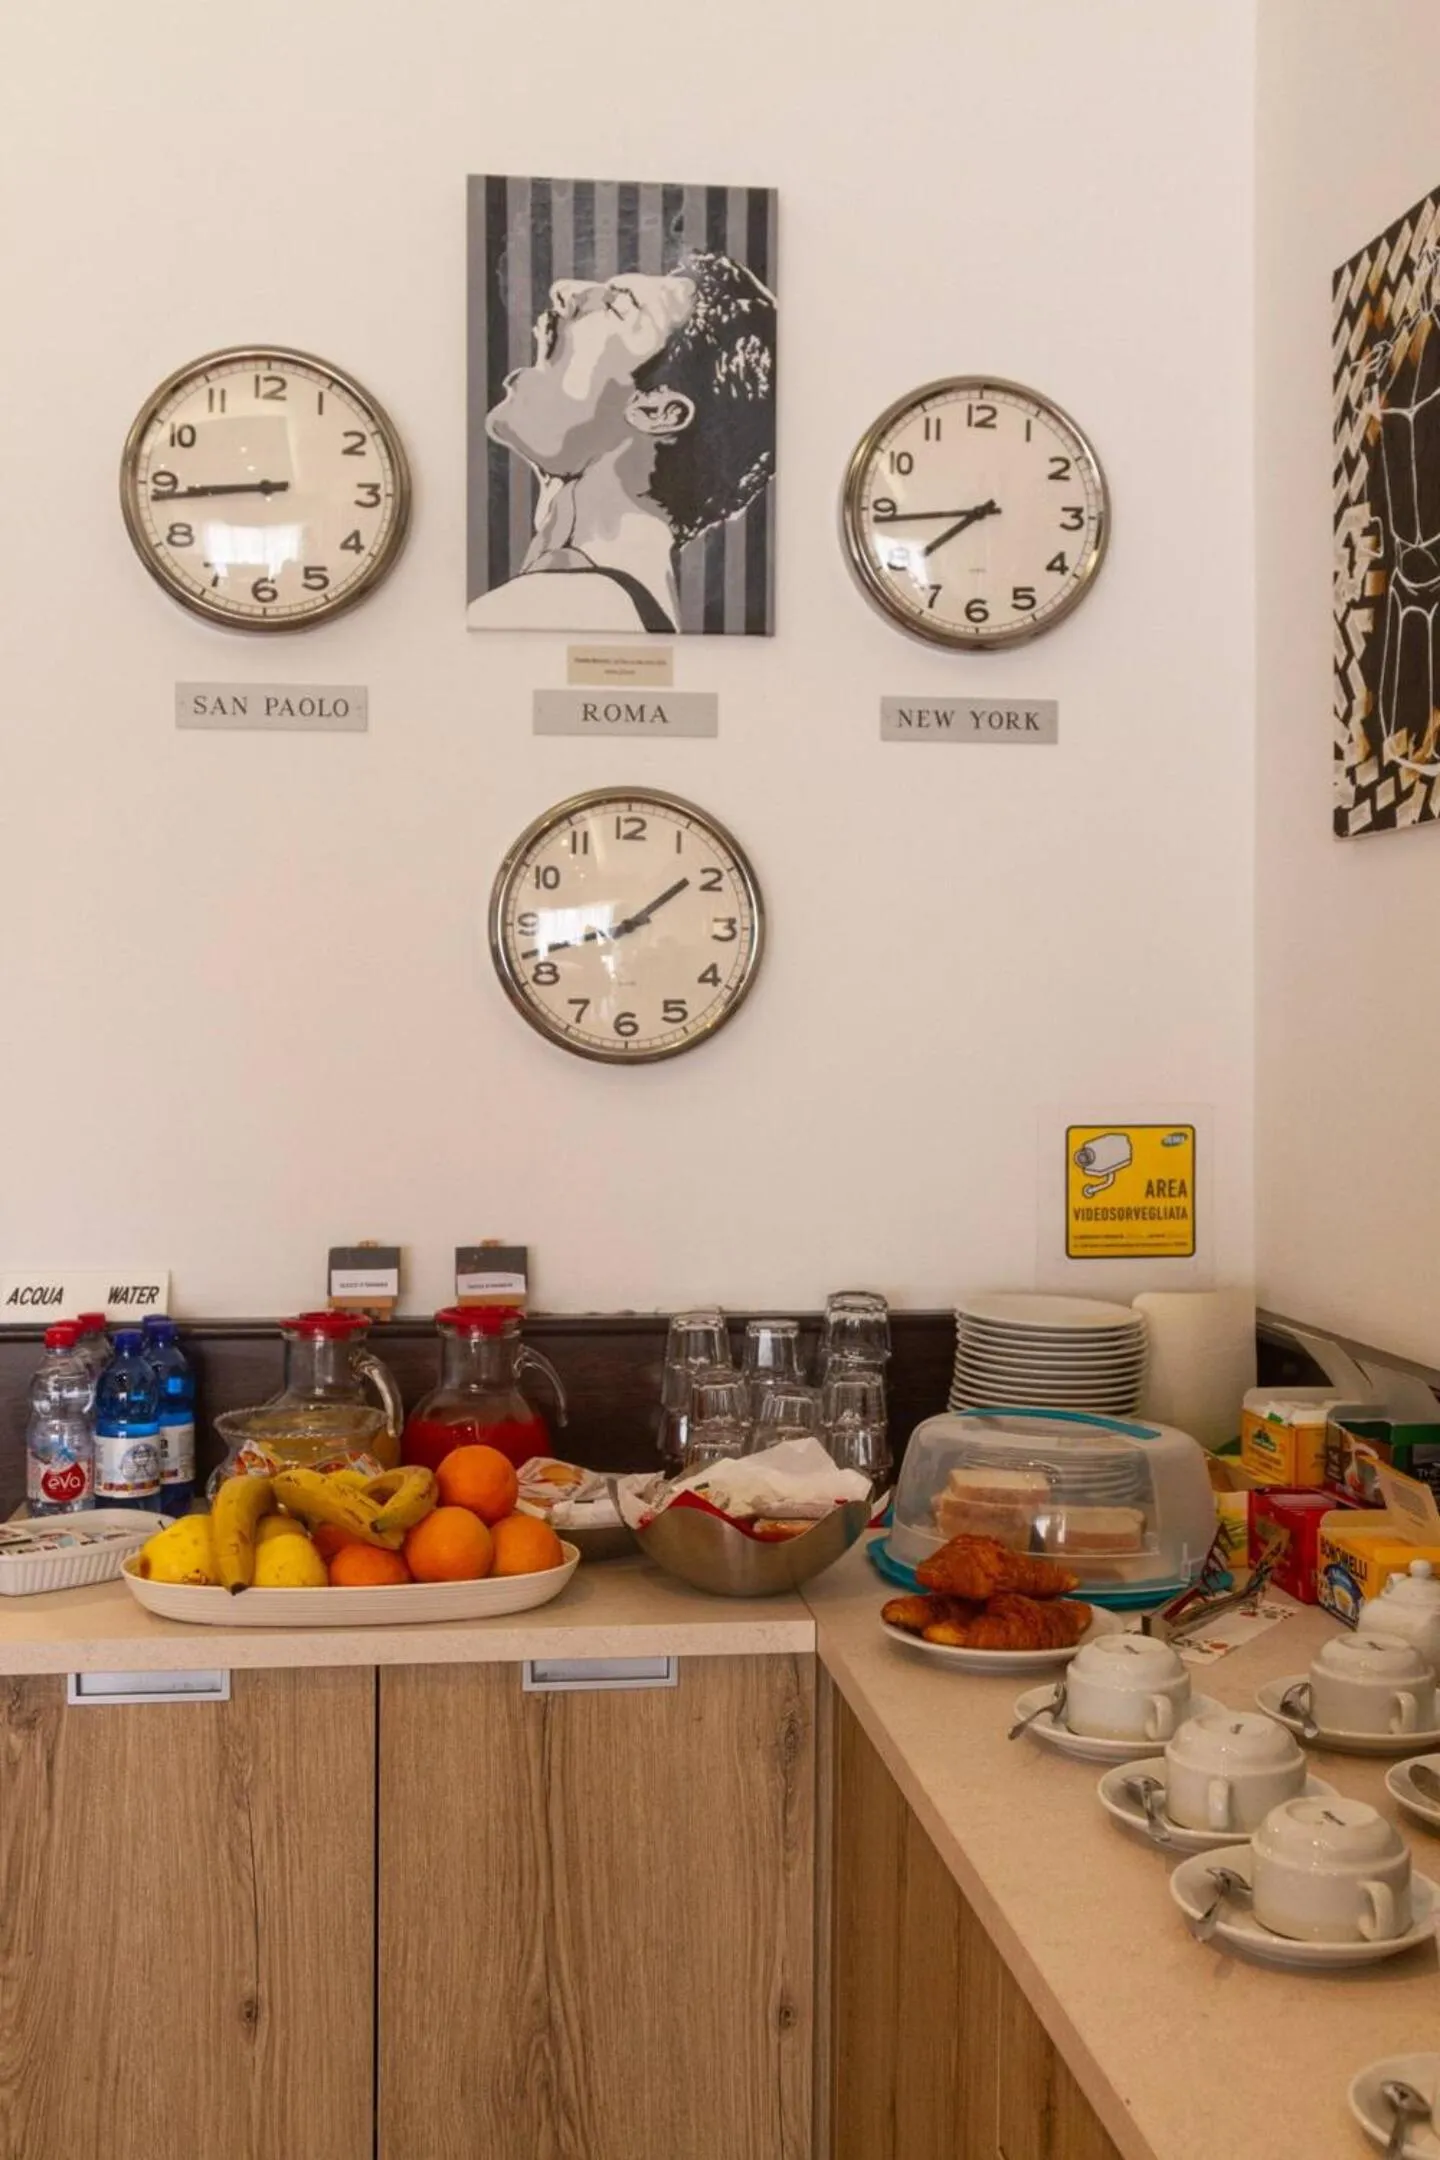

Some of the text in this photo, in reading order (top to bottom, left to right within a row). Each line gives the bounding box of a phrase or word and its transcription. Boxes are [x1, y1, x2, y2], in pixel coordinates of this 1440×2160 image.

[254, 374, 287, 401] 12
[207, 388, 226, 413] 11
[318, 391, 323, 415] 1
[967, 403, 997, 429] 12
[169, 424, 197, 448] 10
[924, 417, 941, 441] 11
[1025, 419, 1031, 442] 1
[341, 431, 366, 456] 2
[890, 452, 913, 475] 10
[1048, 457, 1071, 481] 2
[354, 483, 381, 508] 3
[1060, 506, 1084, 530] 3
[166, 523, 194, 547] 8
[340, 530, 364, 554] 4
[1045, 552, 1069, 575] 4
[251, 577, 278, 602] 6
[302, 566, 329, 590] 5
[921, 584, 942, 609] 7
[1011, 587, 1036, 610] 5
[964, 599, 989, 622] 6
[193, 695, 349, 717] SAN PAOLO
[582, 702, 669, 724] ROMA
[898, 709, 1040, 731] NEW YORK
[616, 816, 647, 840] 12
[571, 831, 588, 854] 11
[676, 830, 682, 854] 1
[535, 866, 560, 889] 10
[699, 868, 723, 892] 2
[712, 917, 737, 942] 3
[532, 962, 560, 985] 8
[697, 963, 721, 987] 4
[568, 999, 590, 1024] 7
[661, 999, 688, 1023] 5
[613, 1012, 639, 1036] 6
[1145, 1179, 1188, 1198] AREA
[1073, 1206, 1188, 1221] VIDEOSORVEGLIATA
[6, 1286, 160, 1305] ACQUA WATER
